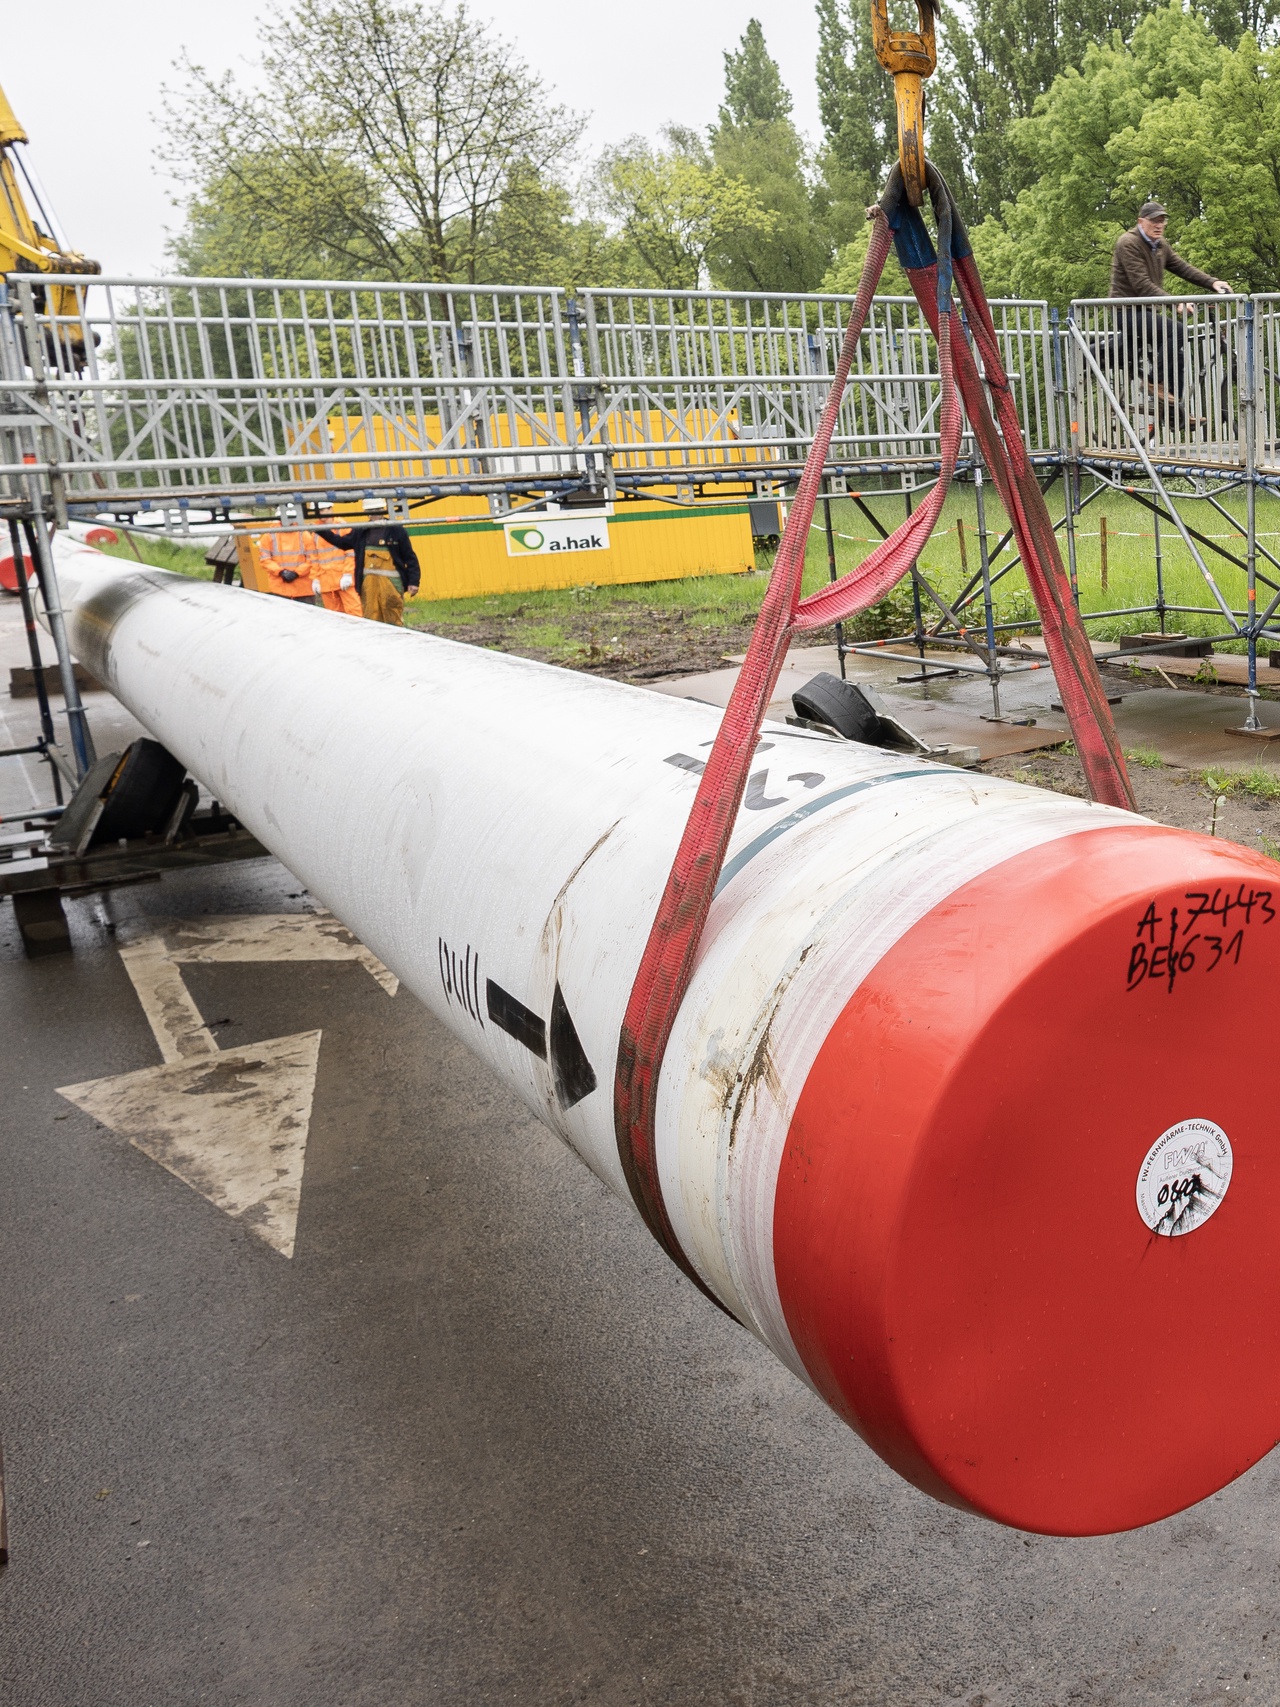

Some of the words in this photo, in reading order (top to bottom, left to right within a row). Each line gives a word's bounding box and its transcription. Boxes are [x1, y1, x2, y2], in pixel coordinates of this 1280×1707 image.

[549, 535, 603, 551] a.hak
[438, 936, 485, 1030] pull
[1215, 1134, 1228, 1156] GmbH
